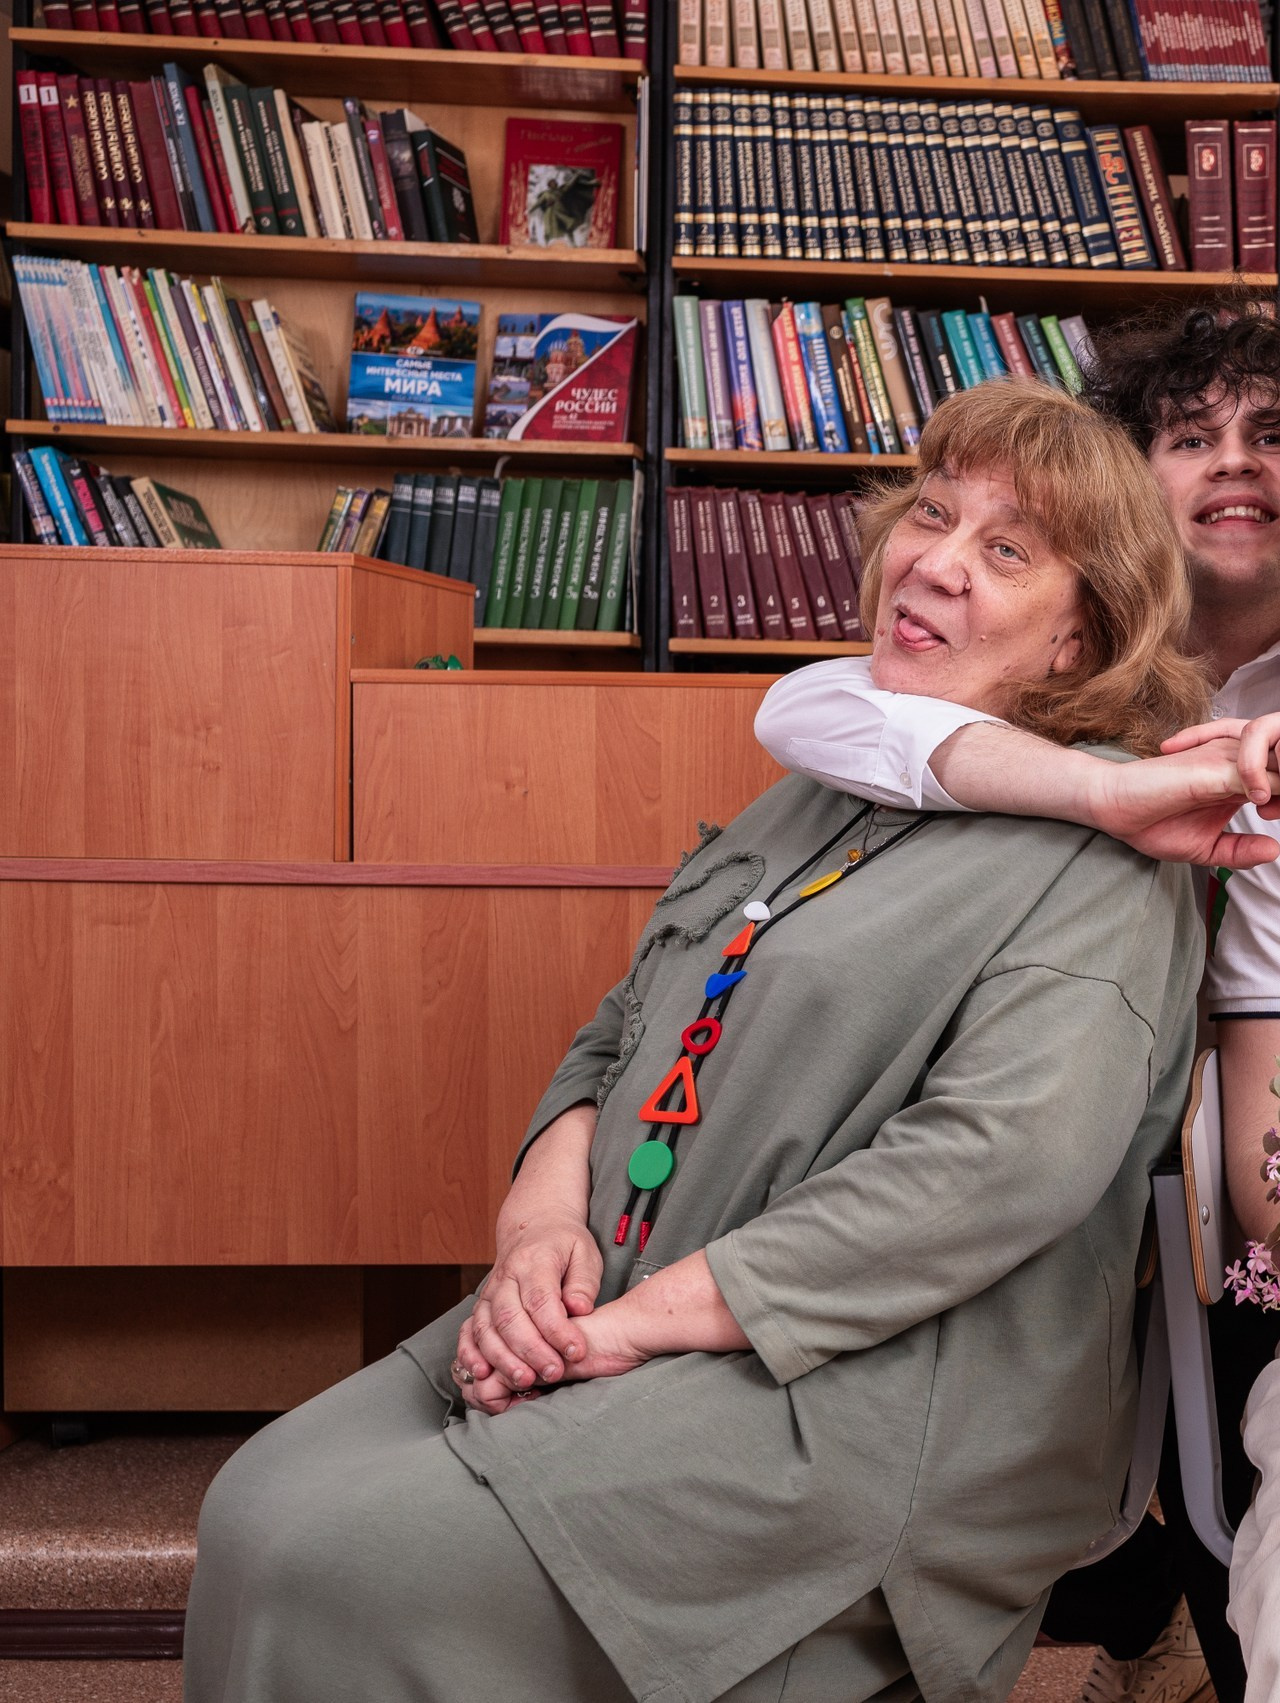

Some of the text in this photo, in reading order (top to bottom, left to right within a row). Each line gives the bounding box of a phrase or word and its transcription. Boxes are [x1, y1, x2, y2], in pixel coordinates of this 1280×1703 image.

[395, 358, 433, 370] САМЫЕ
[365, 366, 463, 382] ИНТЕРЕСНЫЕ МЕСТА
[384, 378, 442, 397] МИРА
[571, 387, 618, 402] ЧУДЕС
[555, 400, 618, 414] РОССИИ
